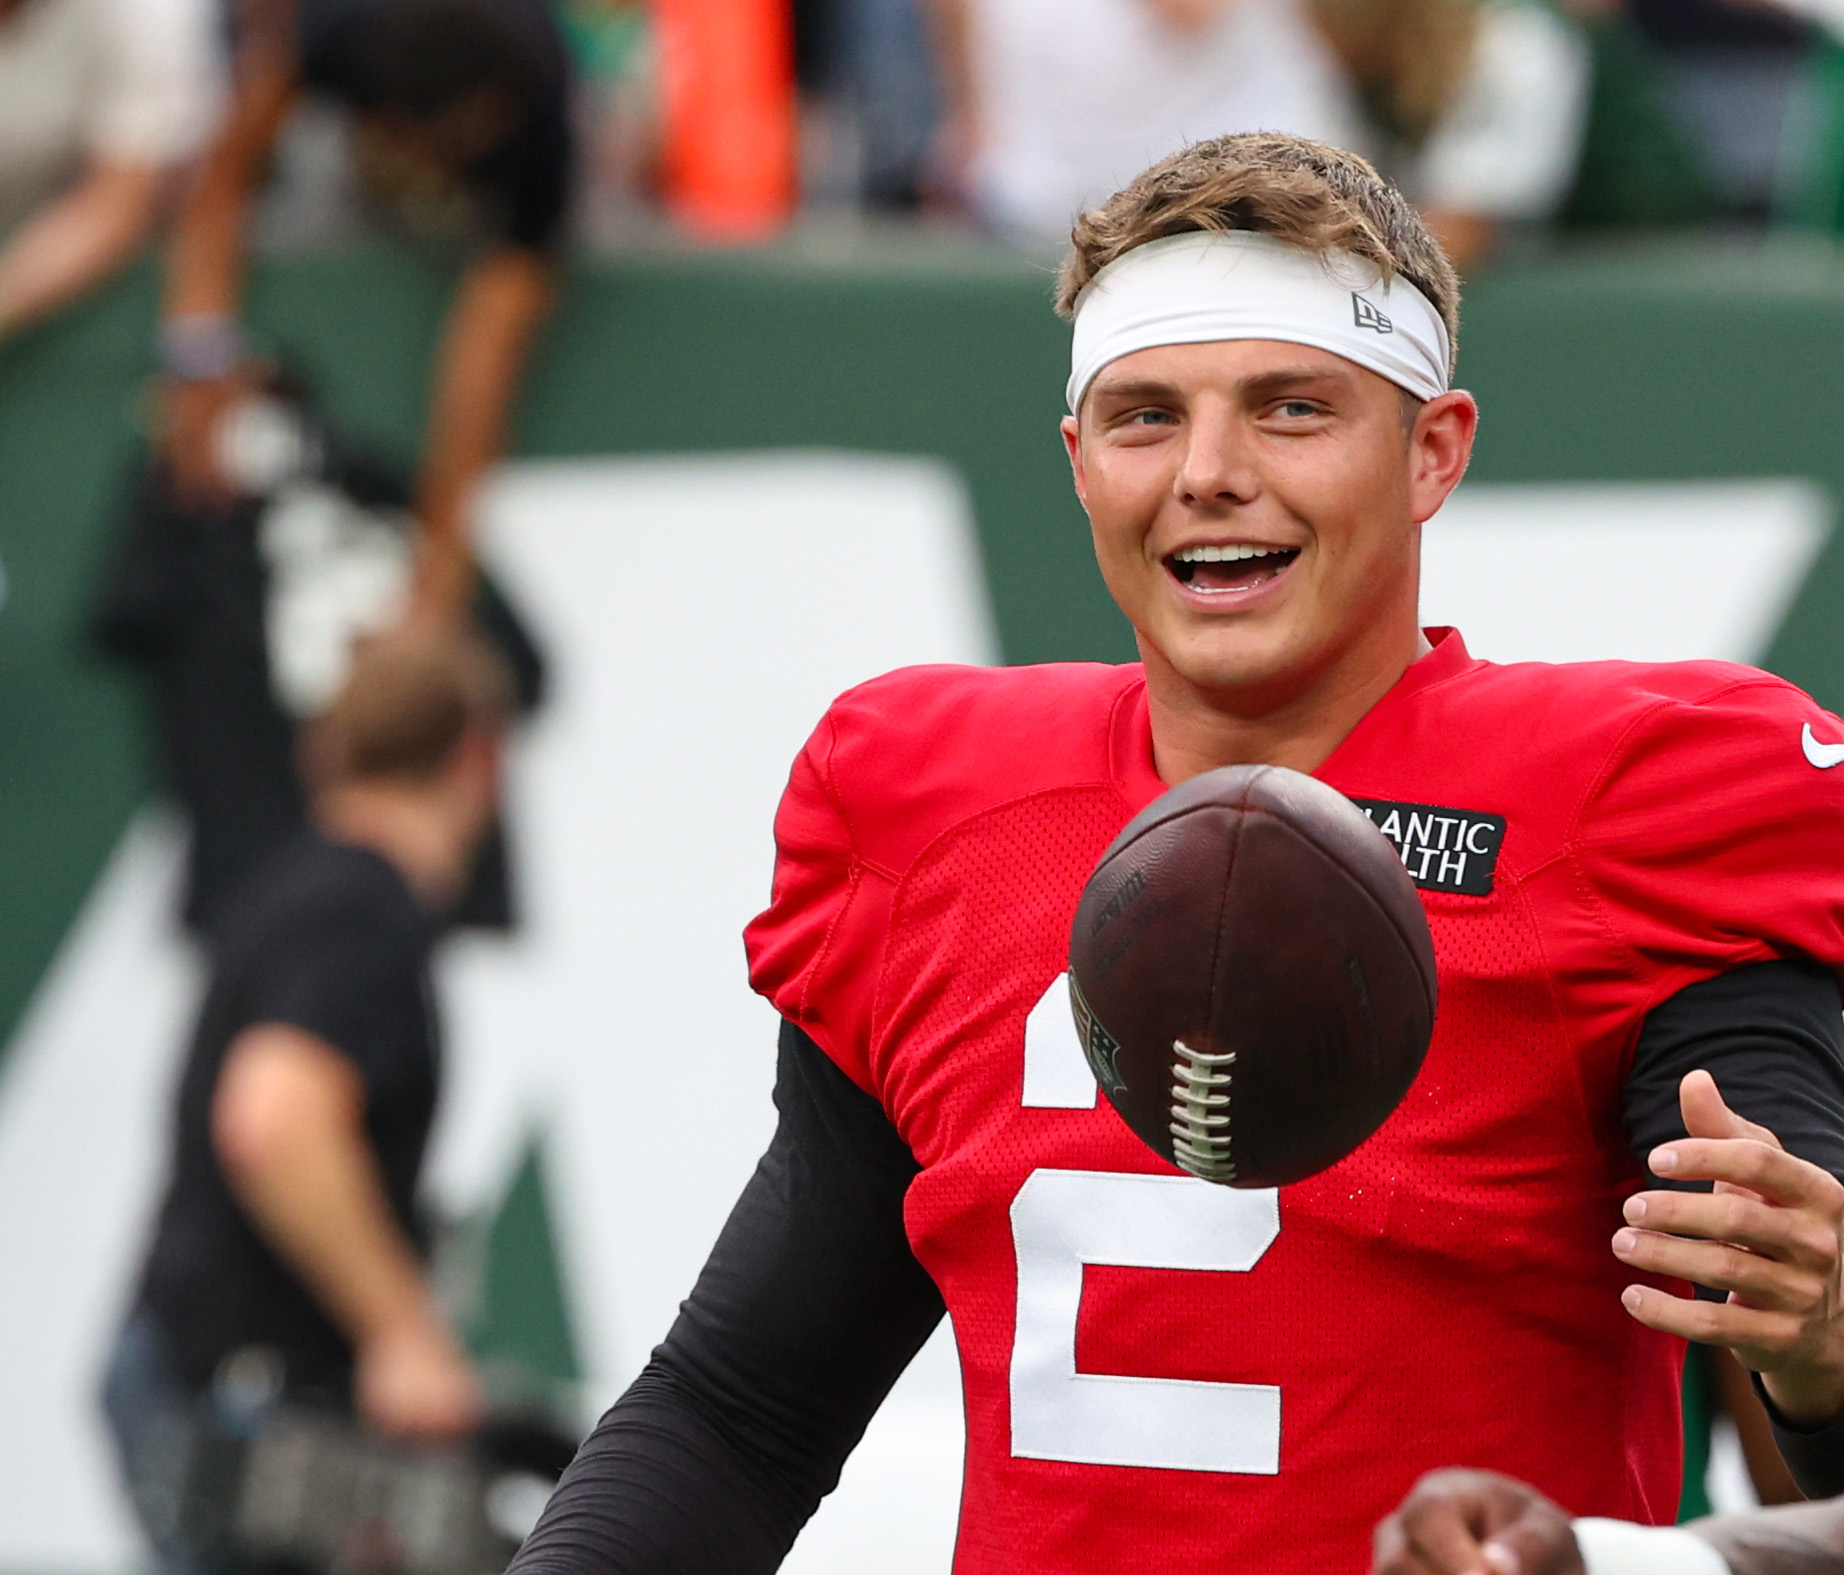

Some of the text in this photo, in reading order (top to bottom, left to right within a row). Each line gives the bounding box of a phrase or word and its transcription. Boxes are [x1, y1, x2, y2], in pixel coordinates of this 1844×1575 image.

[1359, 808, 1496, 855] ANTIC
[1401, 843, 1468, 887] LTH
[1009, 972, 1282, 1475] 2
